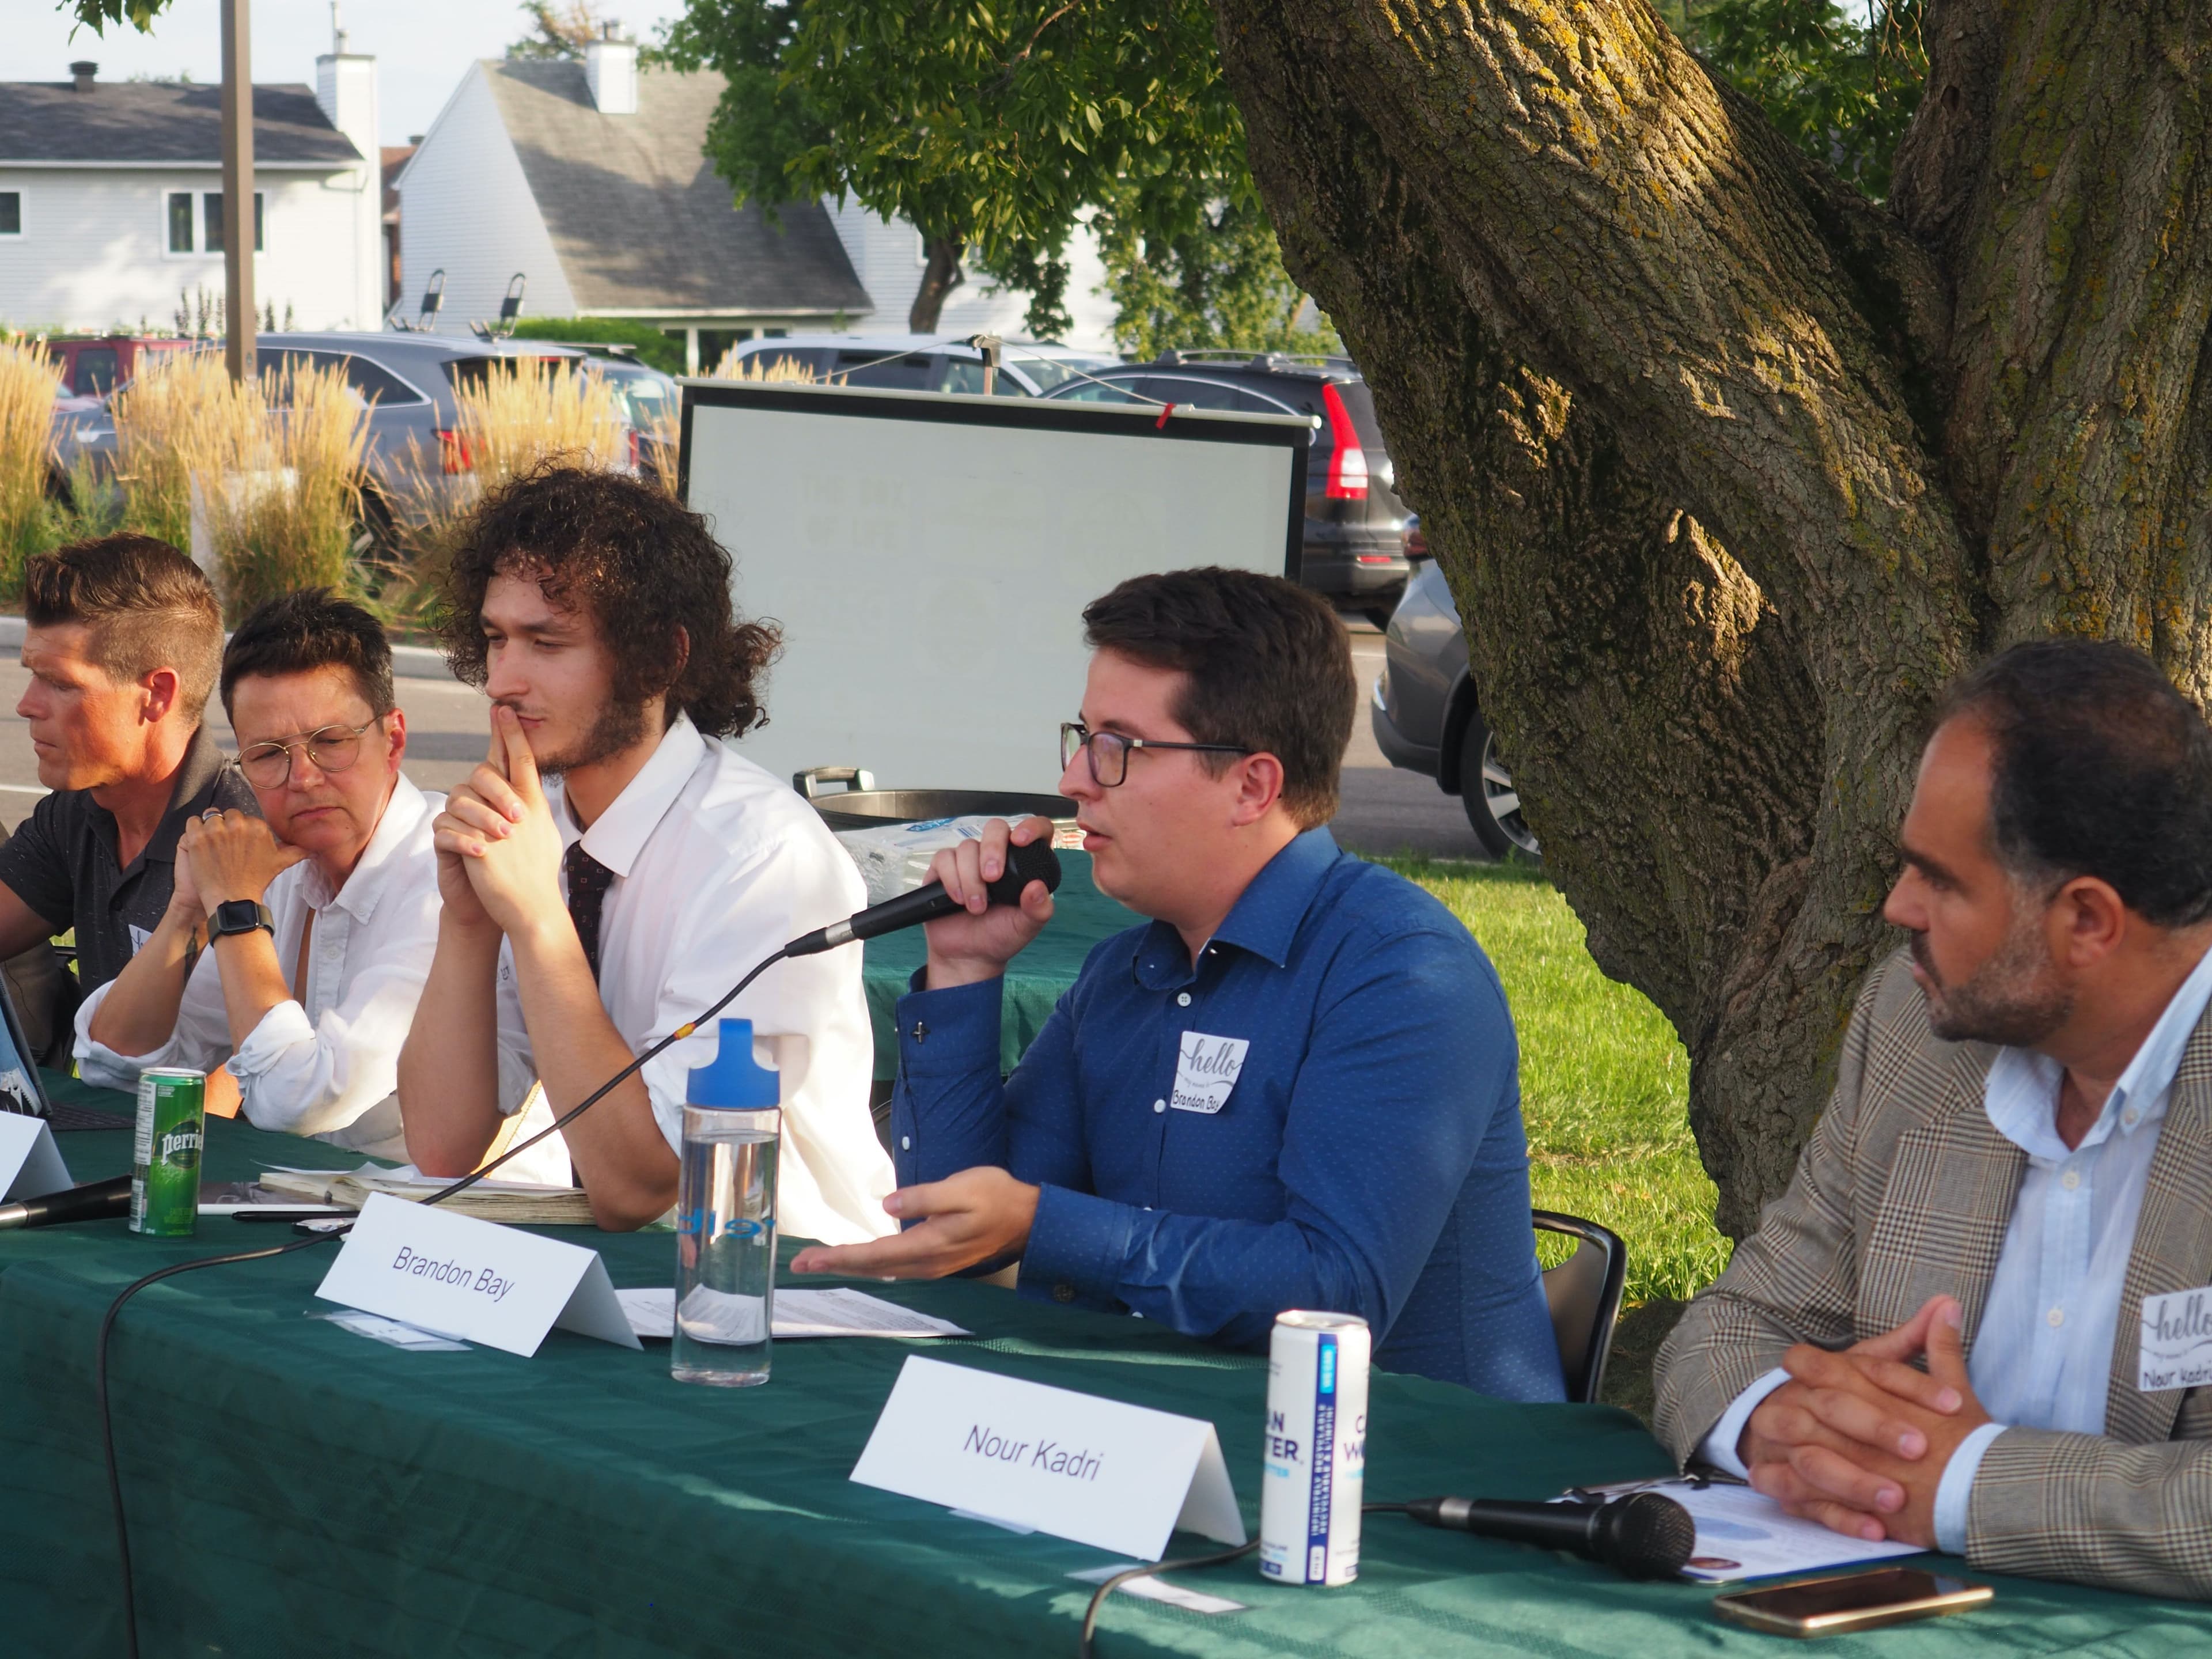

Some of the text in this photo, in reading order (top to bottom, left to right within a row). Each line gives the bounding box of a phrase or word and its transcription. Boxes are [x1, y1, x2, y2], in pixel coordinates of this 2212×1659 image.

[1187, 1039, 1240, 1077] hello
[1173, 1090, 1205, 1109] Brandon
[392, 1246, 516, 1302] Brandon Bay
[2156, 1294, 2212, 1341] hello
[963, 1424, 1104, 1482] Nour Kadri
